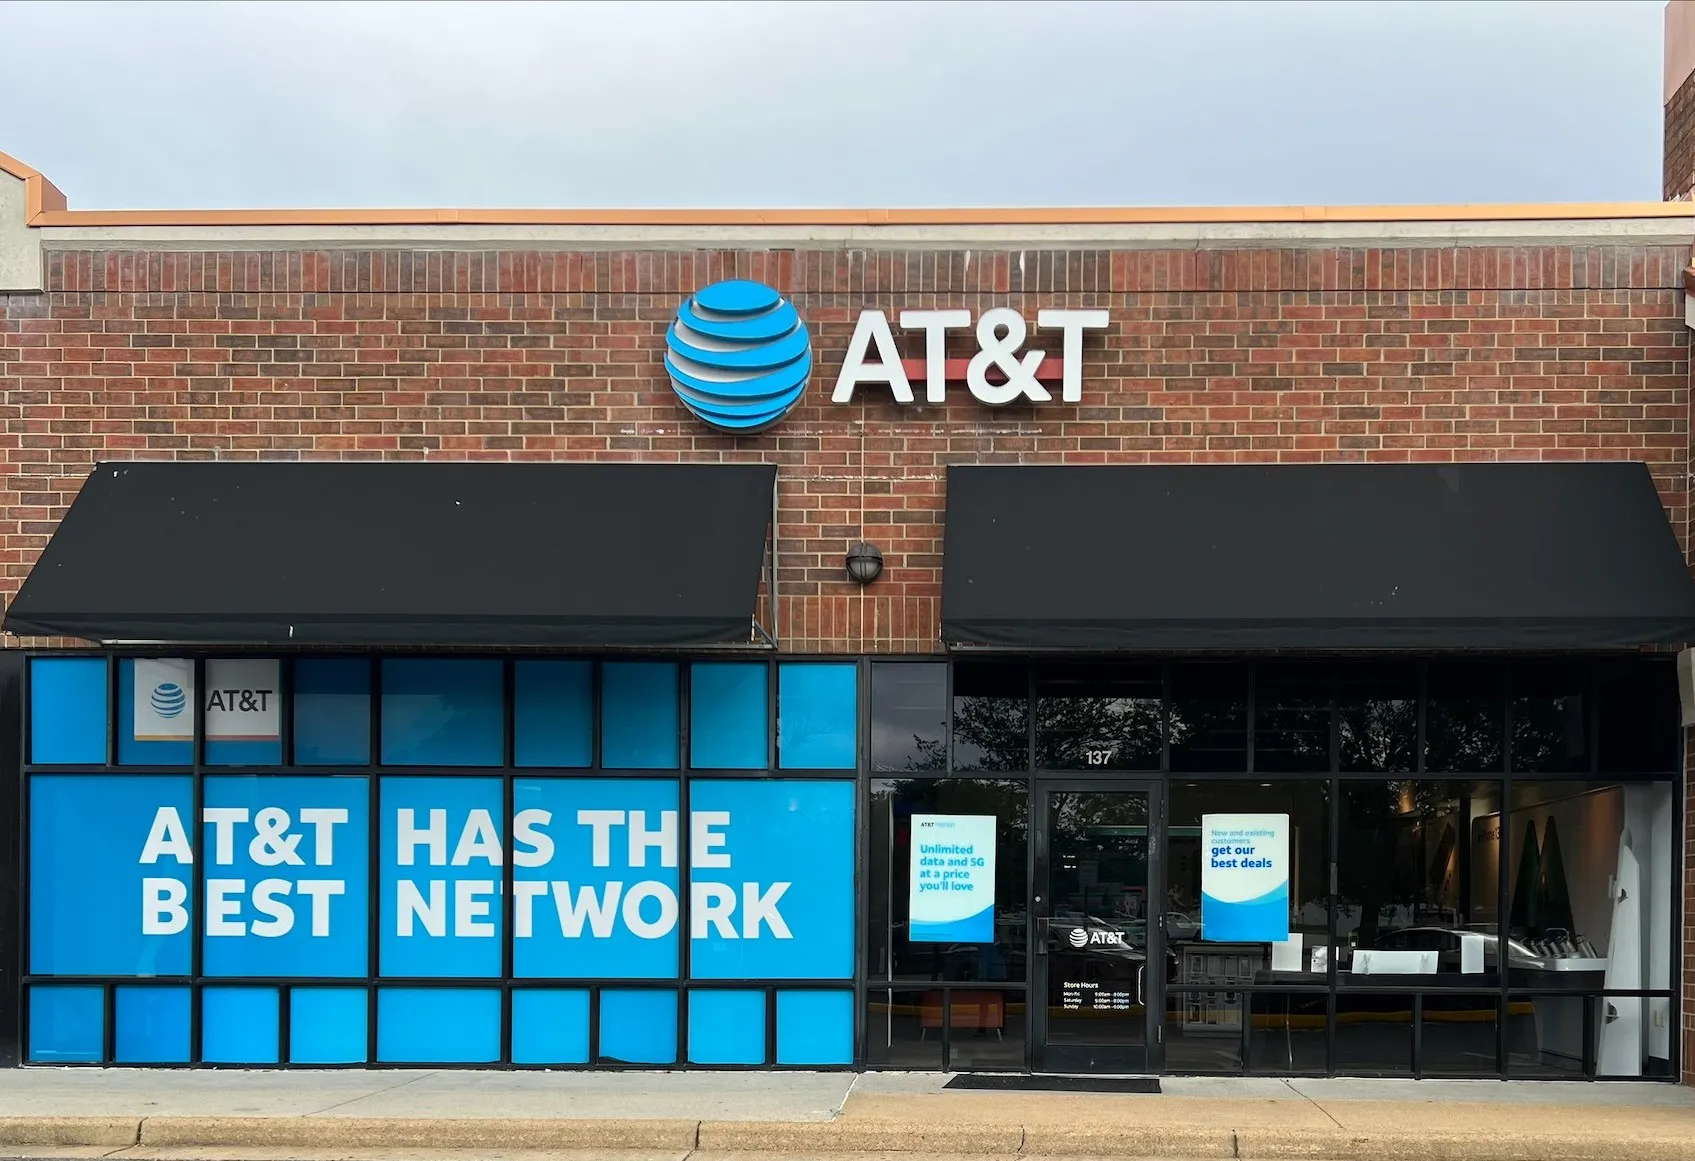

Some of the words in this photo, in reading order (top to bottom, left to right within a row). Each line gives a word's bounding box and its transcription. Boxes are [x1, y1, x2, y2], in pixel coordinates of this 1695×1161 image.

[831, 307, 1109, 405] AT&T
[207, 690, 272, 711] AT&T
[1085, 750, 1112, 764] 137
[138, 806, 348, 866] AT&T
[397, 808, 555, 867] HAS
[577, 810, 731, 868] THE
[1229, 829, 1244, 837] and
[1245, 829, 1275, 838] existing
[920, 844, 973, 854] Unlimited
[1211, 845, 1232, 857] get
[1235, 847, 1255, 855] our
[920, 857, 945, 867] data
[947, 857, 968, 866] and
[970, 857, 985, 867] 5G
[1211, 858, 1237, 868] best
[1240, 857, 1272, 868] deals
[920, 869, 931, 878] at
[934, 870, 940, 878] a
[943, 869, 970, 881] price
[919, 881, 948, 892] you'll
[951, 881, 974, 891] love
[142, 878, 345, 937] BEST
[397, 879, 793, 939] NETWORK
[1090, 931, 1125, 944] AT&T
